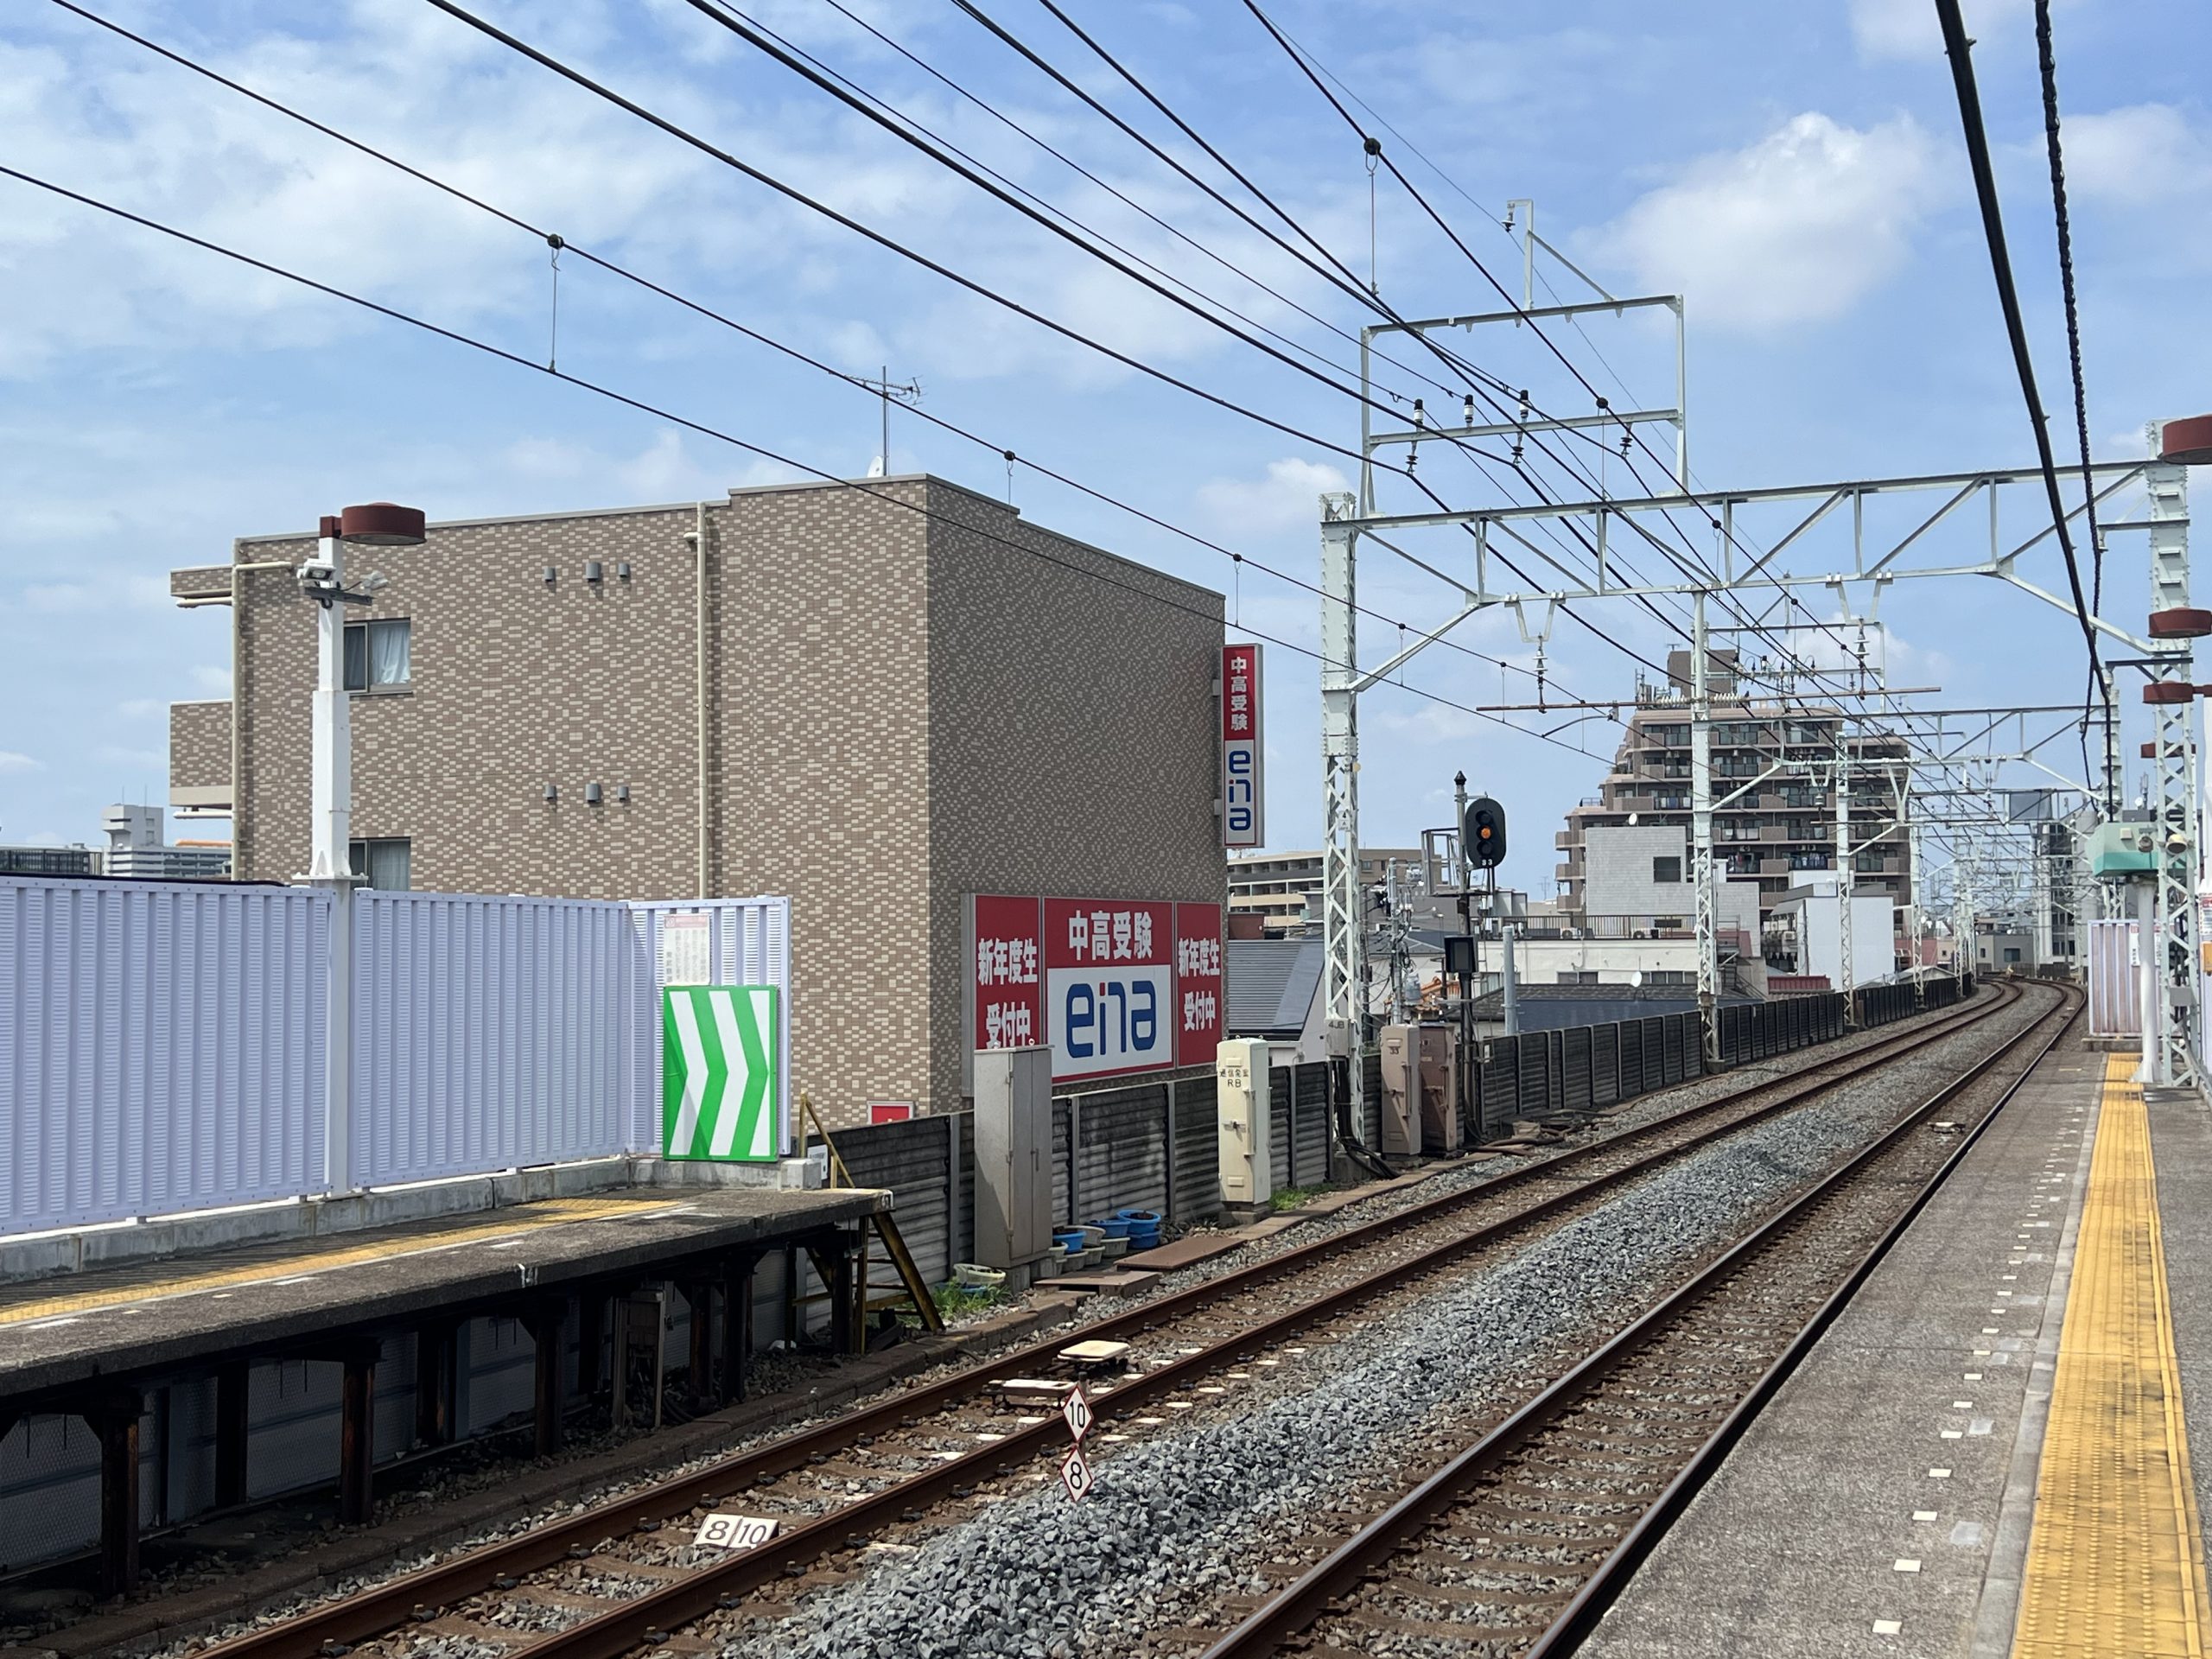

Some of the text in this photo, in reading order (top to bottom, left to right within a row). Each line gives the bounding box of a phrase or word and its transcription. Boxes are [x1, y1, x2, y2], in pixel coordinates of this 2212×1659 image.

[1230, 656, 1249, 731] 中高受験
[1228, 750, 1251, 831] ena
[1068, 910, 1153, 961] 中高受験
[1178, 937, 1220, 978] 新年度生
[977, 937, 1039, 986] 新年度生
[985, 1001, 1031, 1049] 受付中
[1065, 980, 1157, 1058] ena
[1184, 990, 1216, 1032] 受付中
[1227, 1078, 1242, 1088] RB
[1069, 1400, 1085, 1428] 10
[1070, 1461, 1083, 1490] 8
[704, 1520, 767, 1545] 8 10
